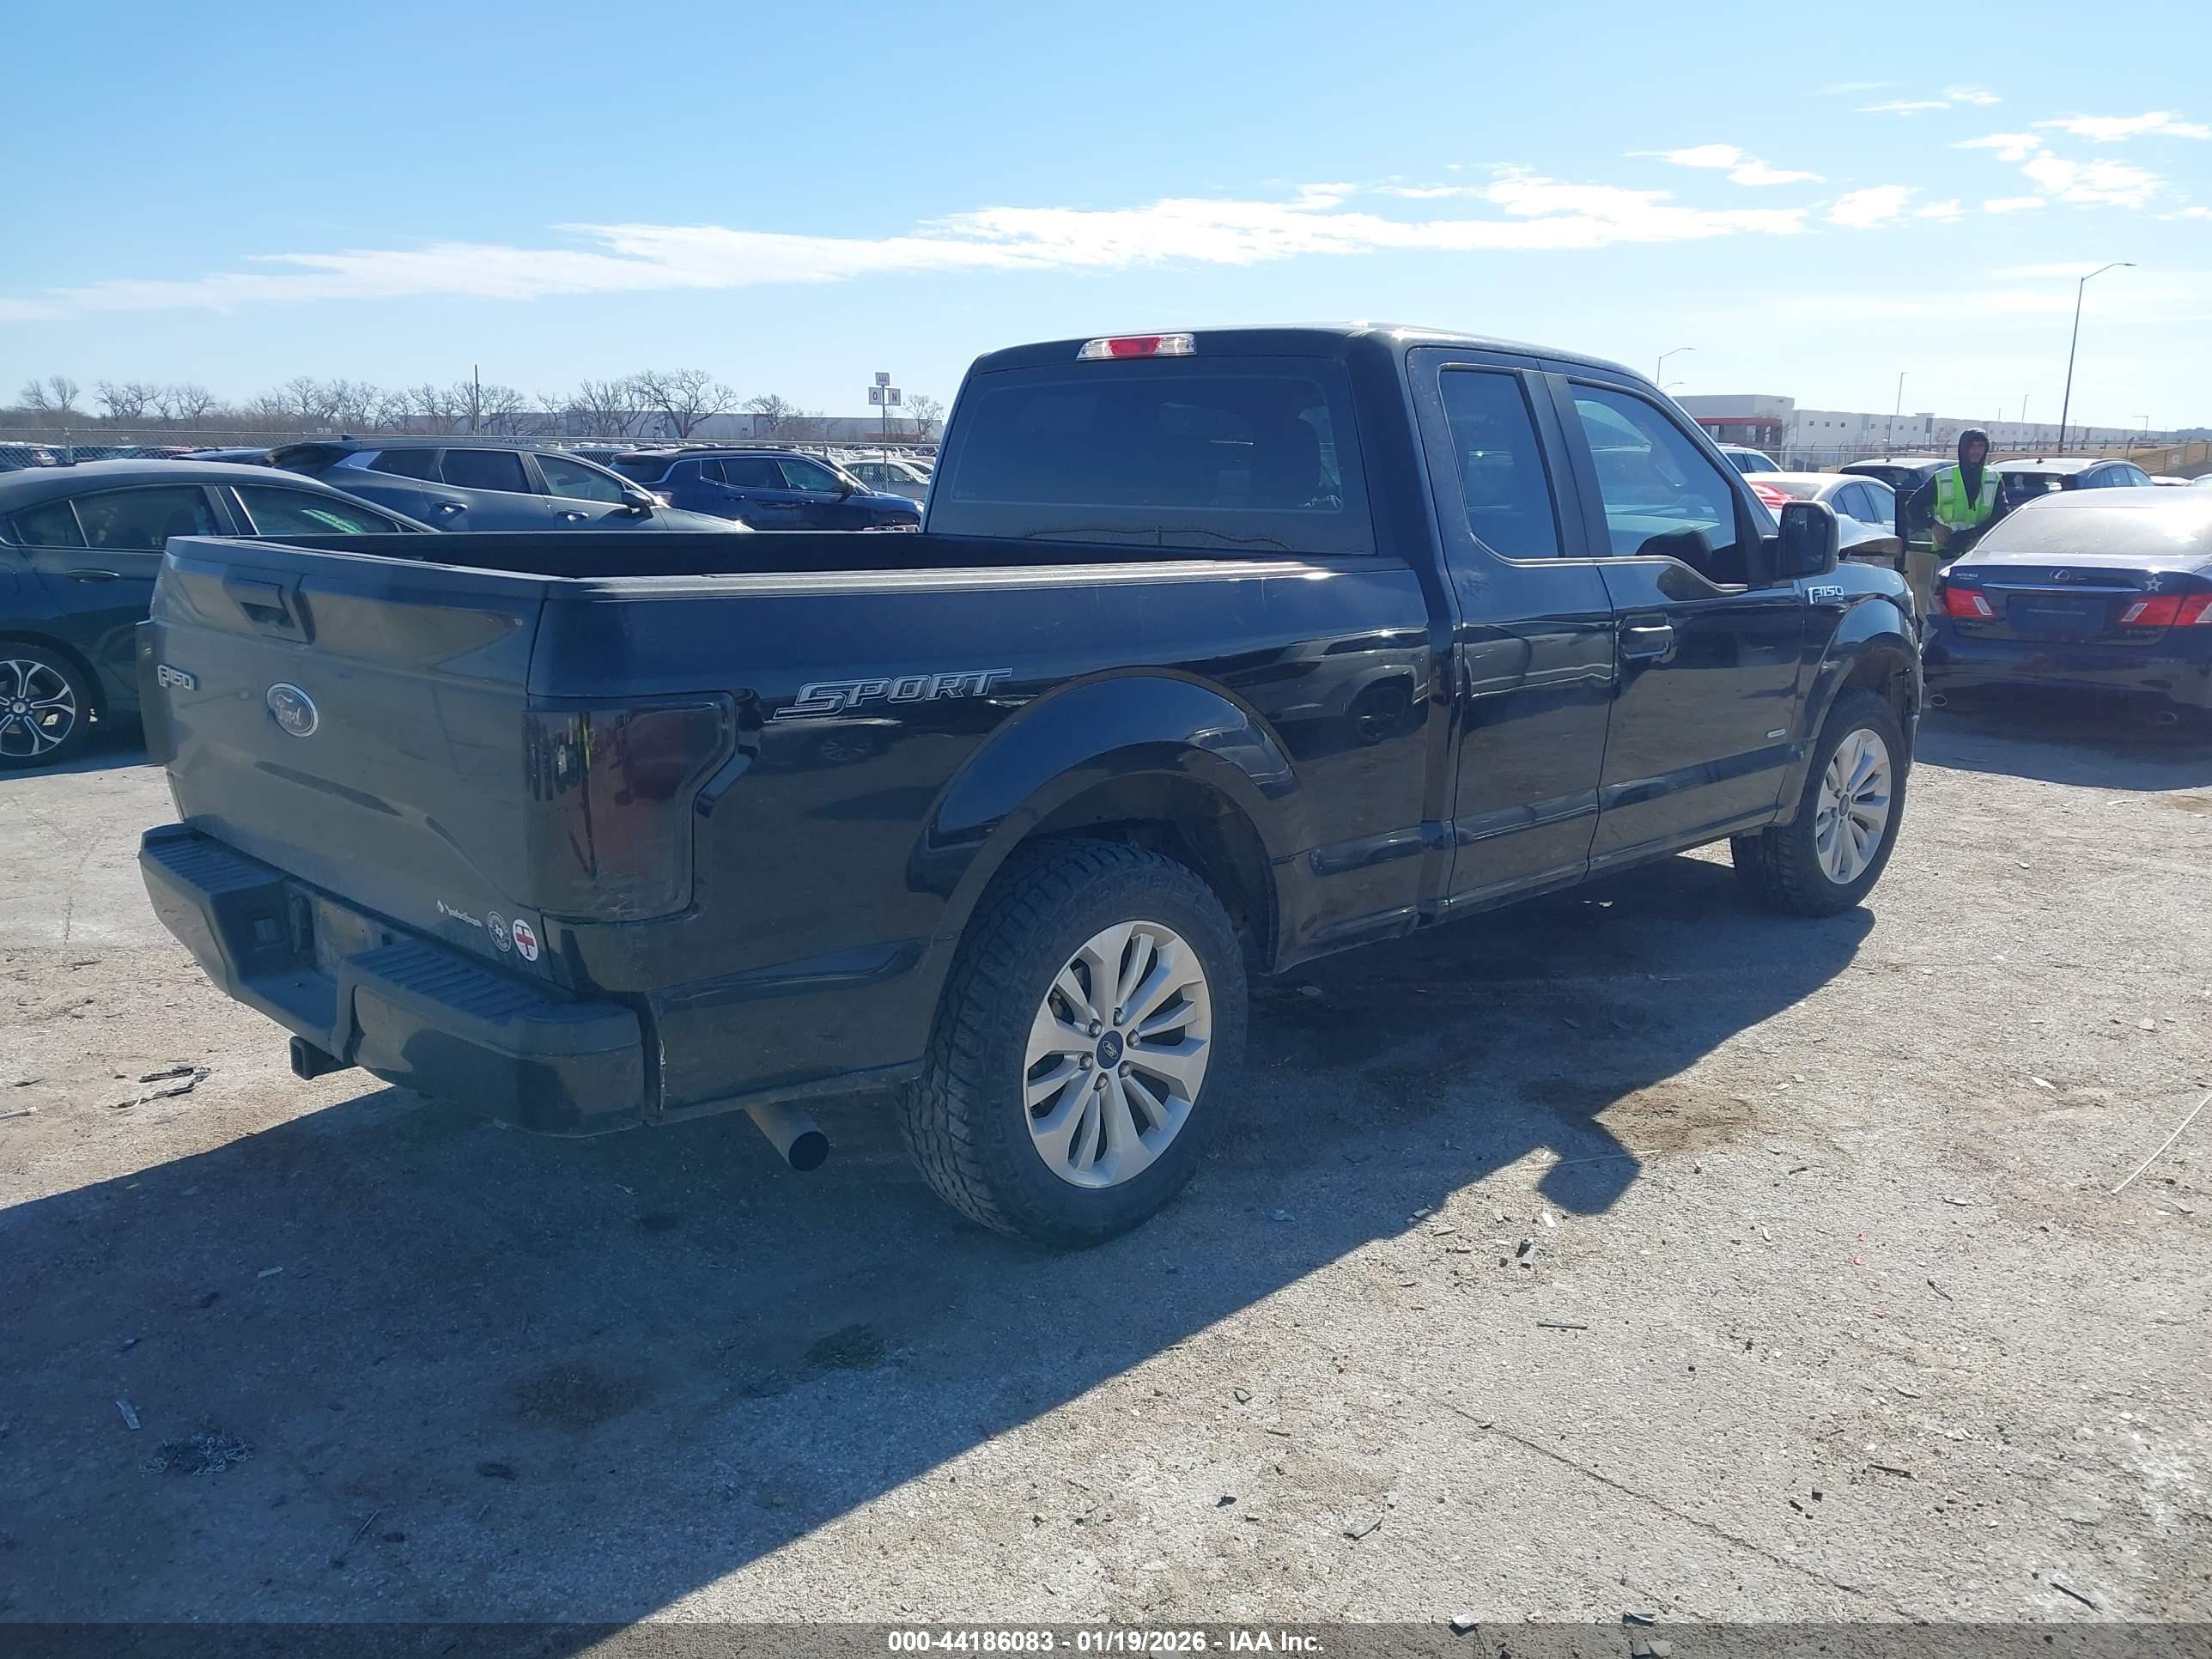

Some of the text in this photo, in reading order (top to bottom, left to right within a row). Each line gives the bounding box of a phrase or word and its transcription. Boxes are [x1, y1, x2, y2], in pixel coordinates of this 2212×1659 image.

[891, 392, 898, 403] N
[1808, 585, 1844, 605] F150
[157, 664, 196, 690] F150
[773, 667, 1013, 720] SPORT
[274, 694, 302, 726] Ford
